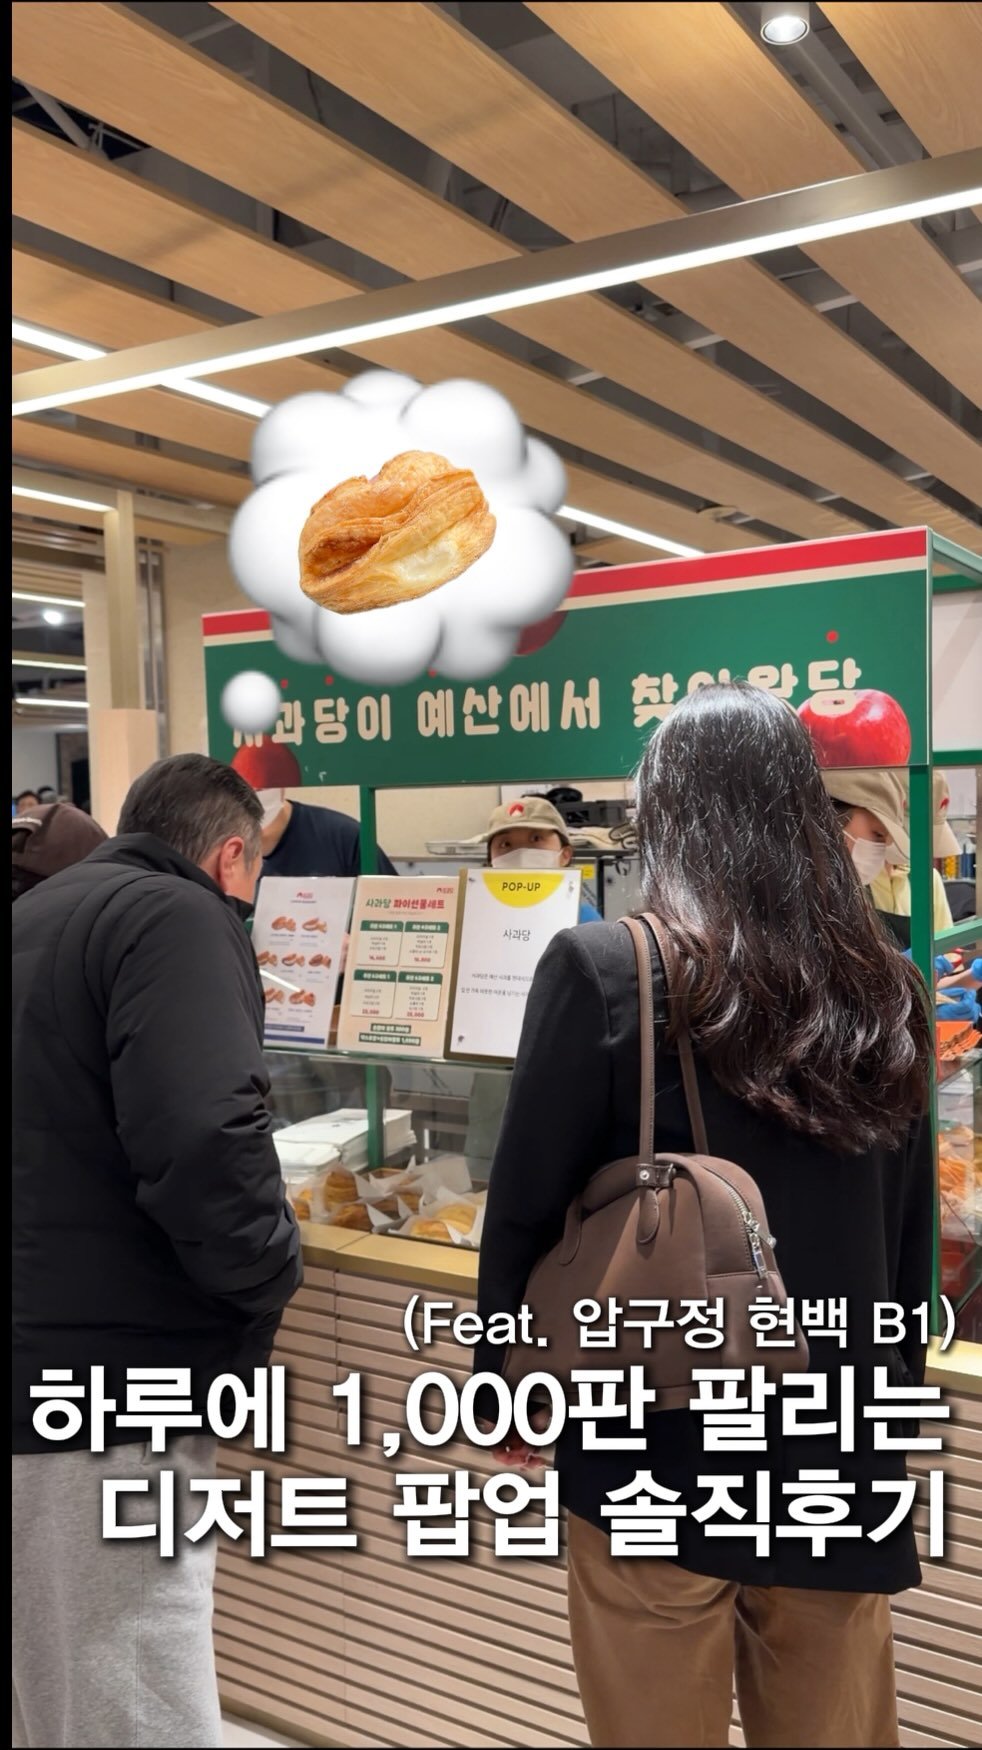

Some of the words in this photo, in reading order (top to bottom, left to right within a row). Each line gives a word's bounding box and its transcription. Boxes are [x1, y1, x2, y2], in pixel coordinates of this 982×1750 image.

[416, 677, 601, 739] 예산에서
[501, 881, 541, 892] POP-UP
[502, 928, 531, 942] 사과당
